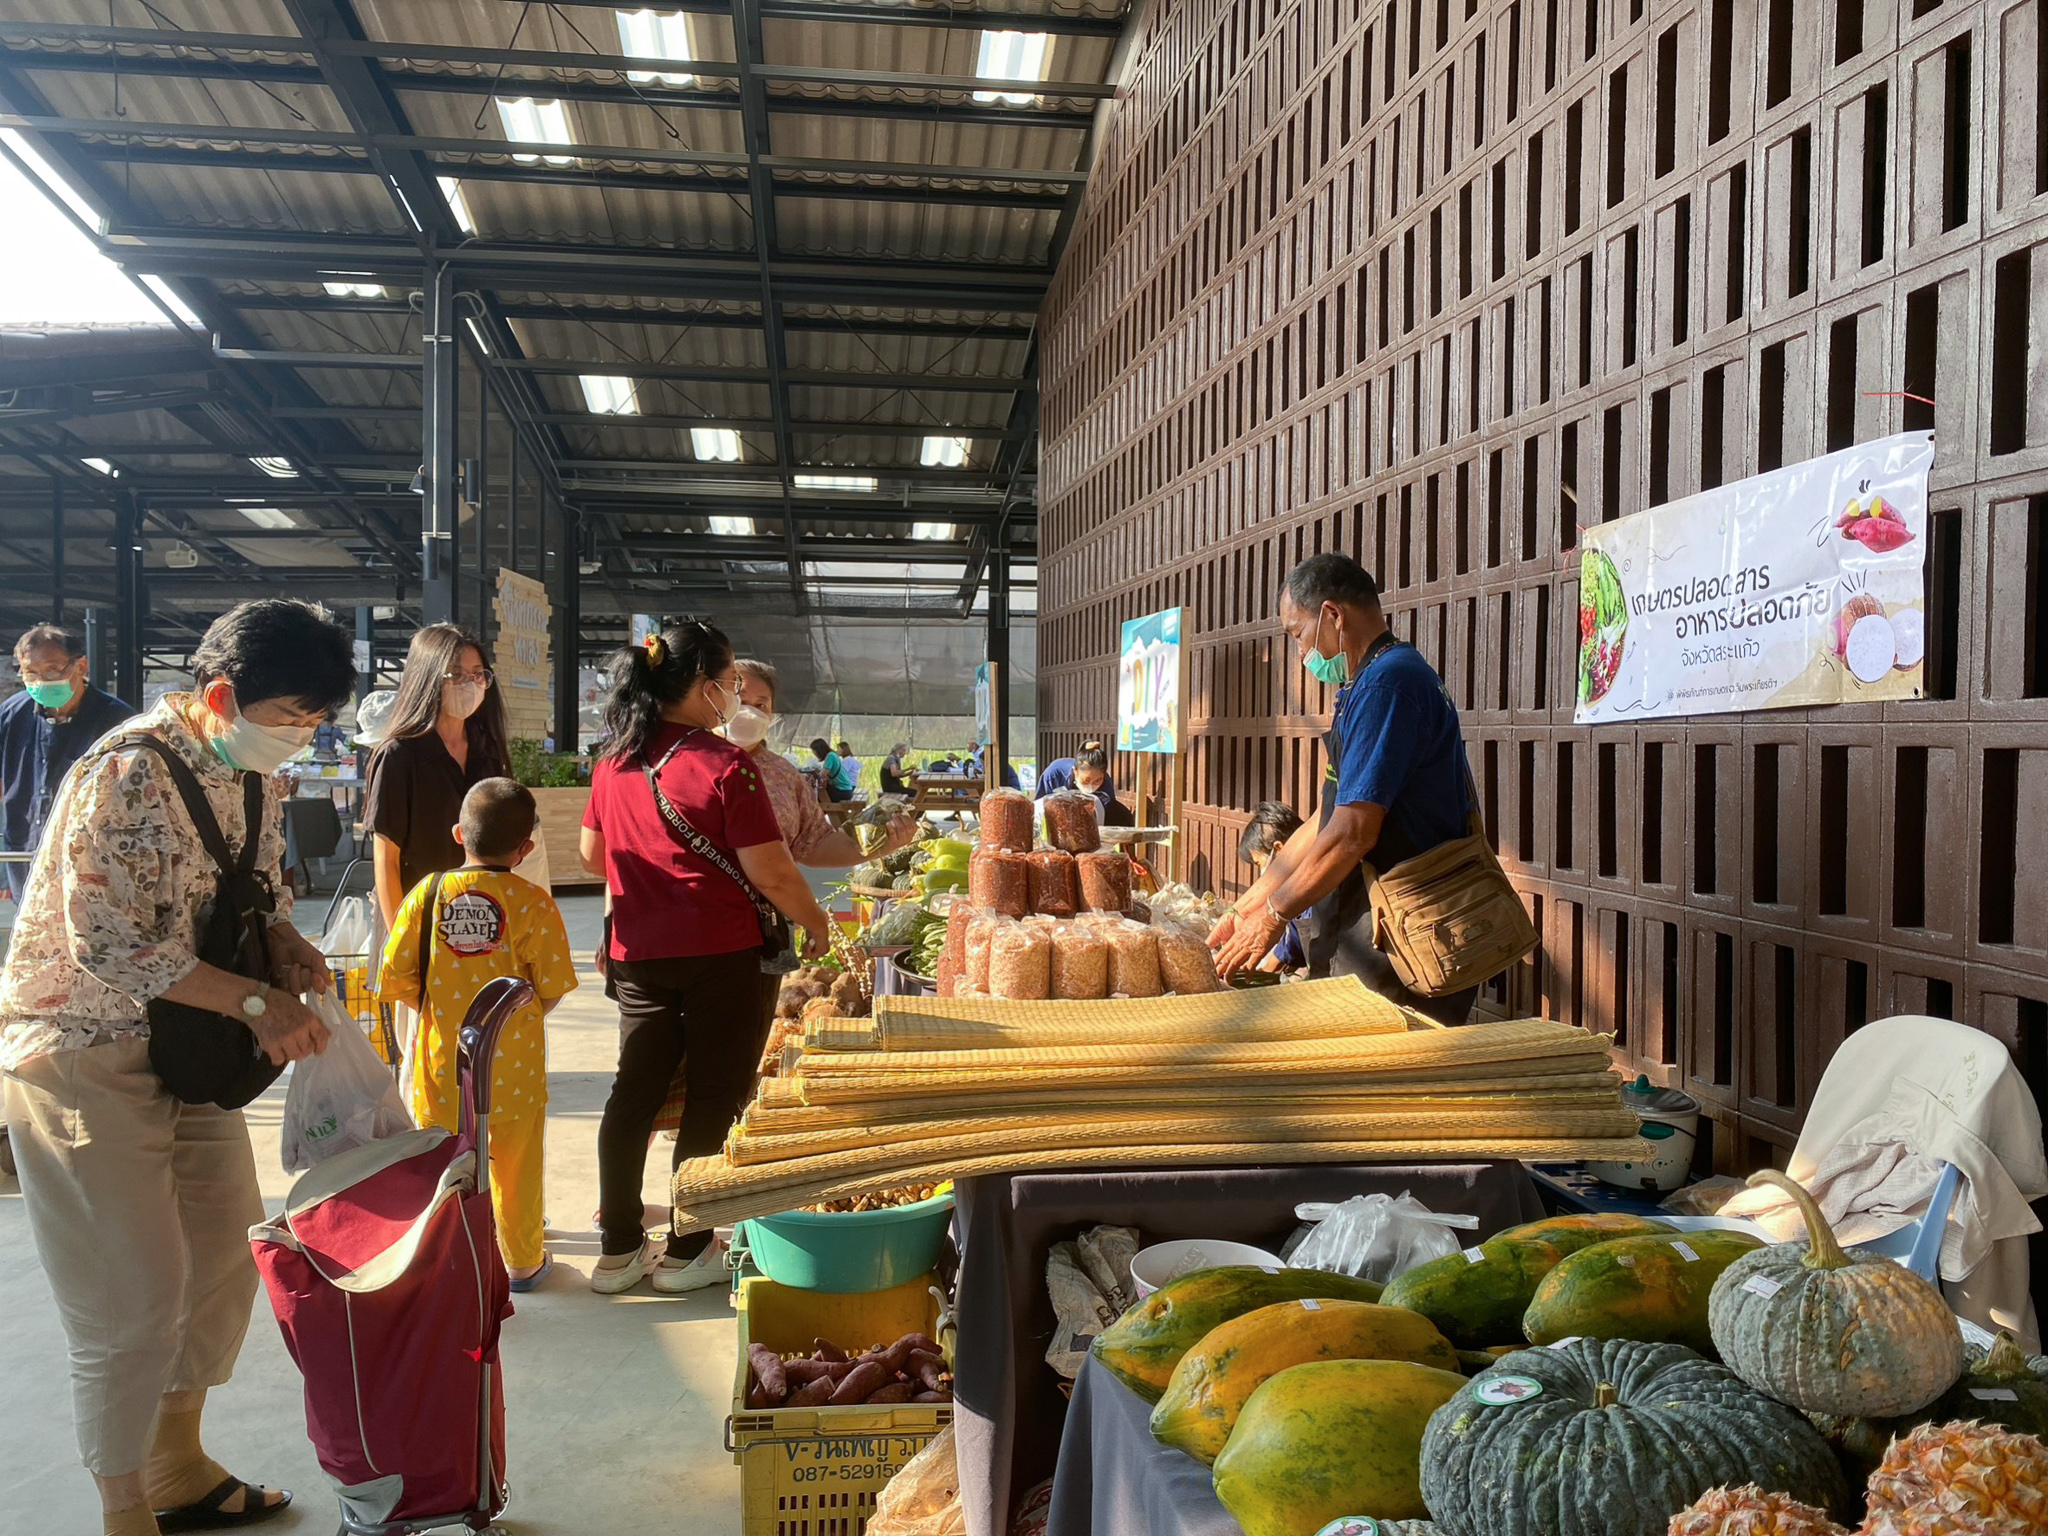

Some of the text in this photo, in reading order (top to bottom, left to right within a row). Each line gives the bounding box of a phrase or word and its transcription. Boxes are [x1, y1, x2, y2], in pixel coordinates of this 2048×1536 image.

[1631, 565, 1770, 616] เกษตรปลอดสาร
[1676, 582, 1831, 639] อาหารปลอดภัย
[1681, 638, 1760, 667] จังหวัดสระแก้ว
[1132, 654, 1165, 713] DIY
[654, 788, 696, 840] FOREVER
[701, 843, 745, 886] FOREVER
[436, 921, 502, 942] SLAYER
[438, 903, 502, 922] DEMON
